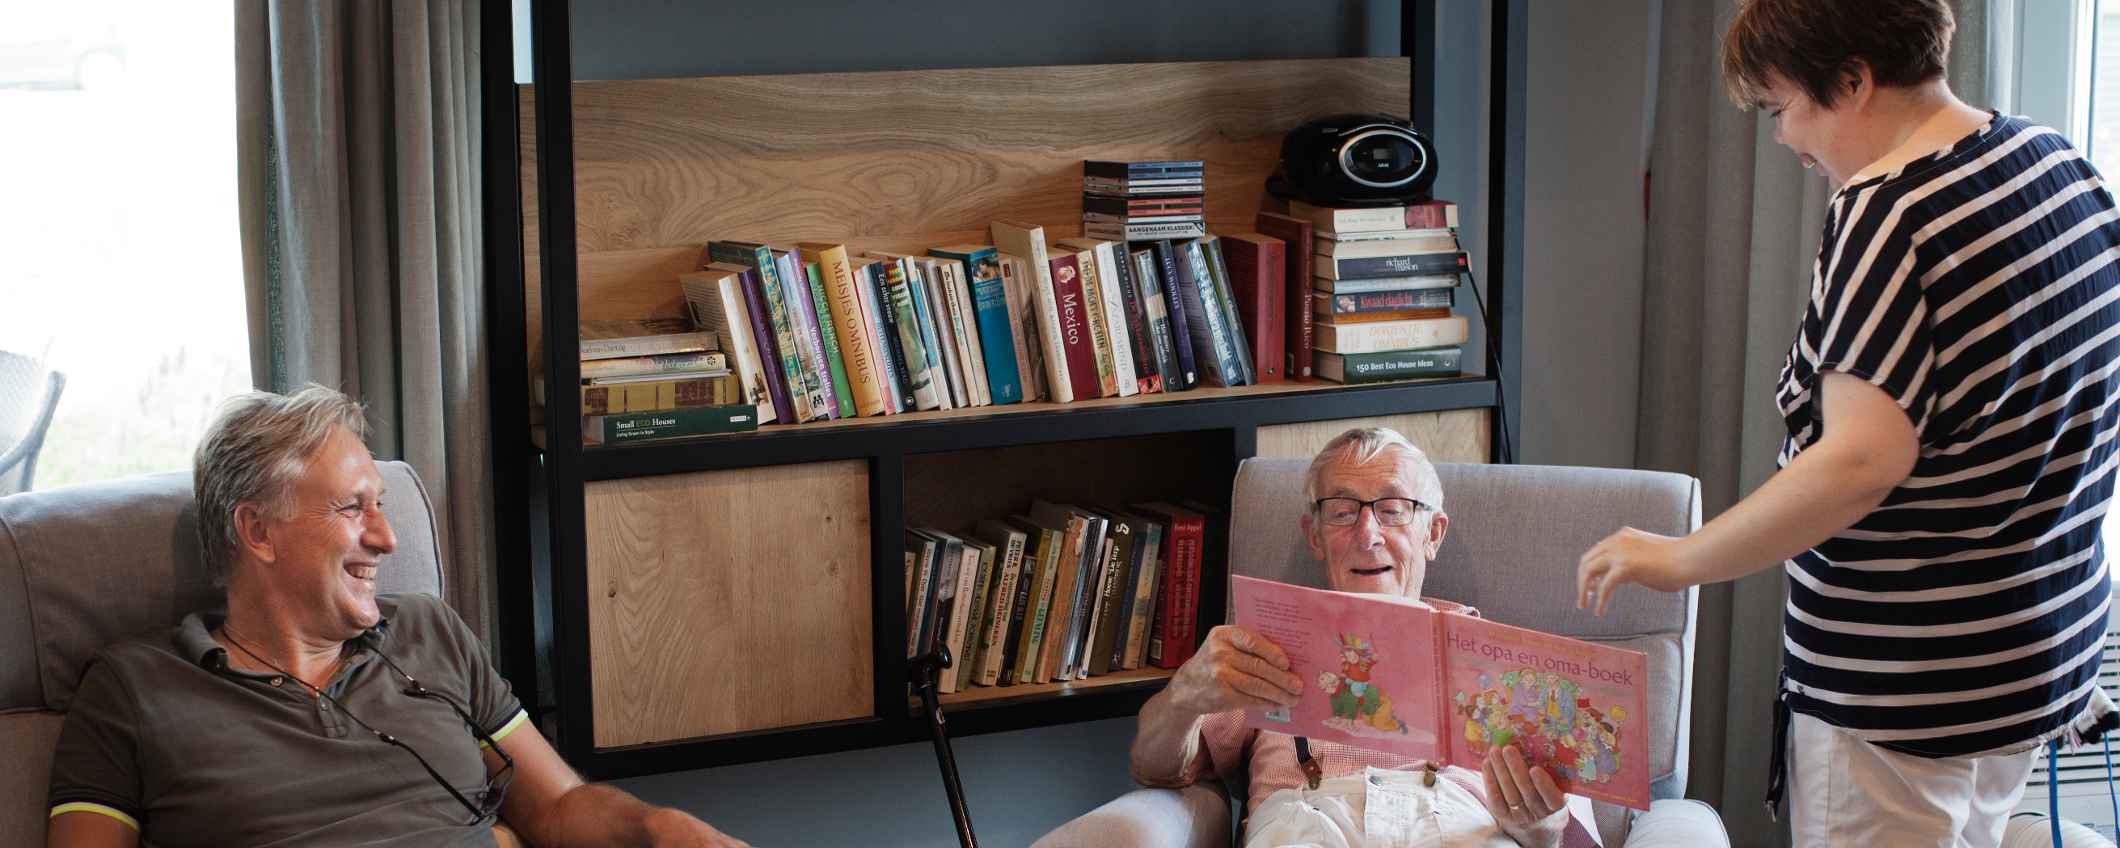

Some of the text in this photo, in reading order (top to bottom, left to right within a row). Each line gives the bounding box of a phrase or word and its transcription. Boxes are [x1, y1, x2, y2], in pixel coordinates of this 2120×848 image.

[1386, 257, 1410, 267] richard
[832, 261, 870, 384] MEISJES OMNIBUS
[1062, 293, 1078, 344] Mexico
[1356, 363, 1369, 373] 150
[616, 420, 634, 429] Small
[1446, 631, 1477, 652] Het
[1481, 643, 1513, 663] opa
[1518, 651, 1540, 667] en
[1543, 656, 1635, 687] oma-boek
